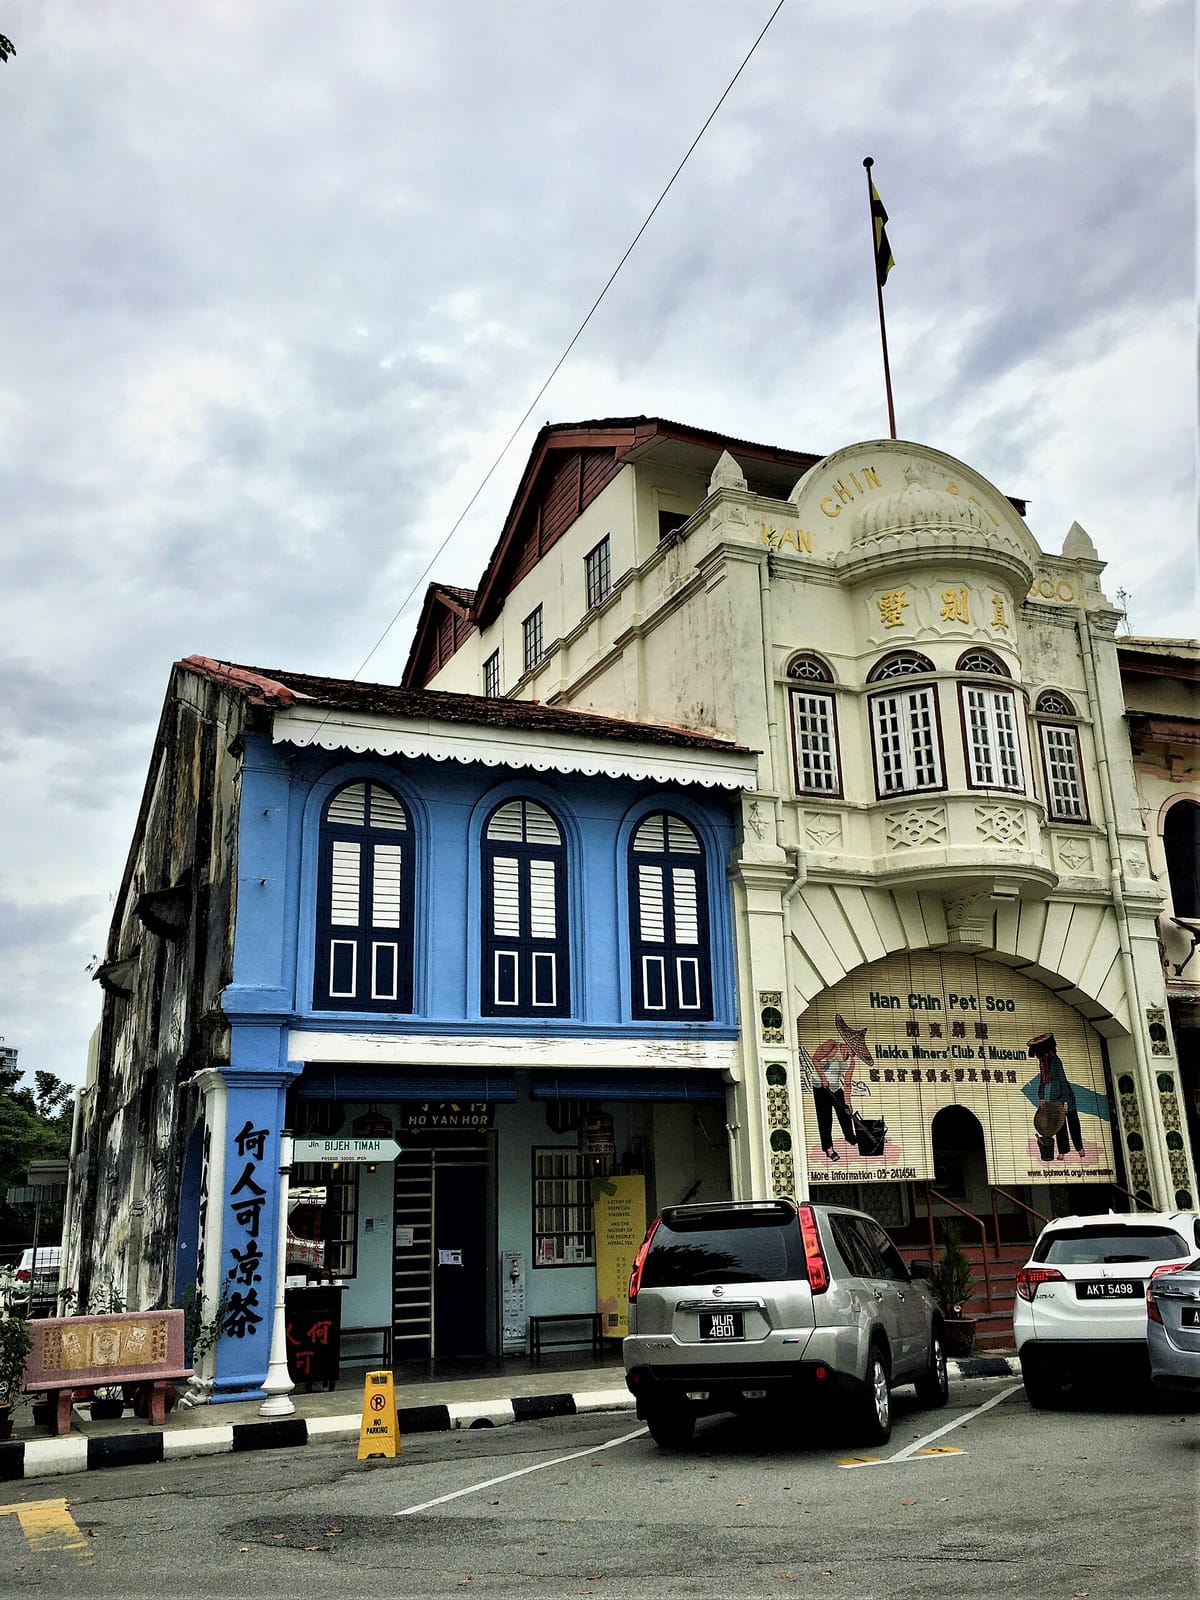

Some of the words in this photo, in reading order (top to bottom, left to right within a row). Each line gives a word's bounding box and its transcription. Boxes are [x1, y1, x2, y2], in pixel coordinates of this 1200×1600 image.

[820, 466, 881, 518] CHIN
[869, 992, 901, 1009] Han
[908, 993, 942, 1010] Chin
[949, 993, 977, 1011] Pet
[986, 995, 1016, 1012] Soo
[874, 1044, 909, 1059] Hakka
[951, 1044, 974, 1059] Club
[978, 1045, 985, 1059] &
[989, 1046, 1027, 1060] Museum
[408, 1115, 427, 1125] HO
[431, 1115, 458, 1125] YAN
[462, 1115, 488, 1125] HOR
[324, 1141, 350, 1151] BIJEH
[353, 1140, 380, 1151] TIMAH
[811, 1171, 829, 1180] More
[1086, 1284, 1106, 1295] AKT
[1107, 1283, 1134, 1294] 5498
[711, 1314, 734, 1326] WUR
[709, 1325, 735, 1337] 4801
[366, 1426, 388, 1434] PARKING
